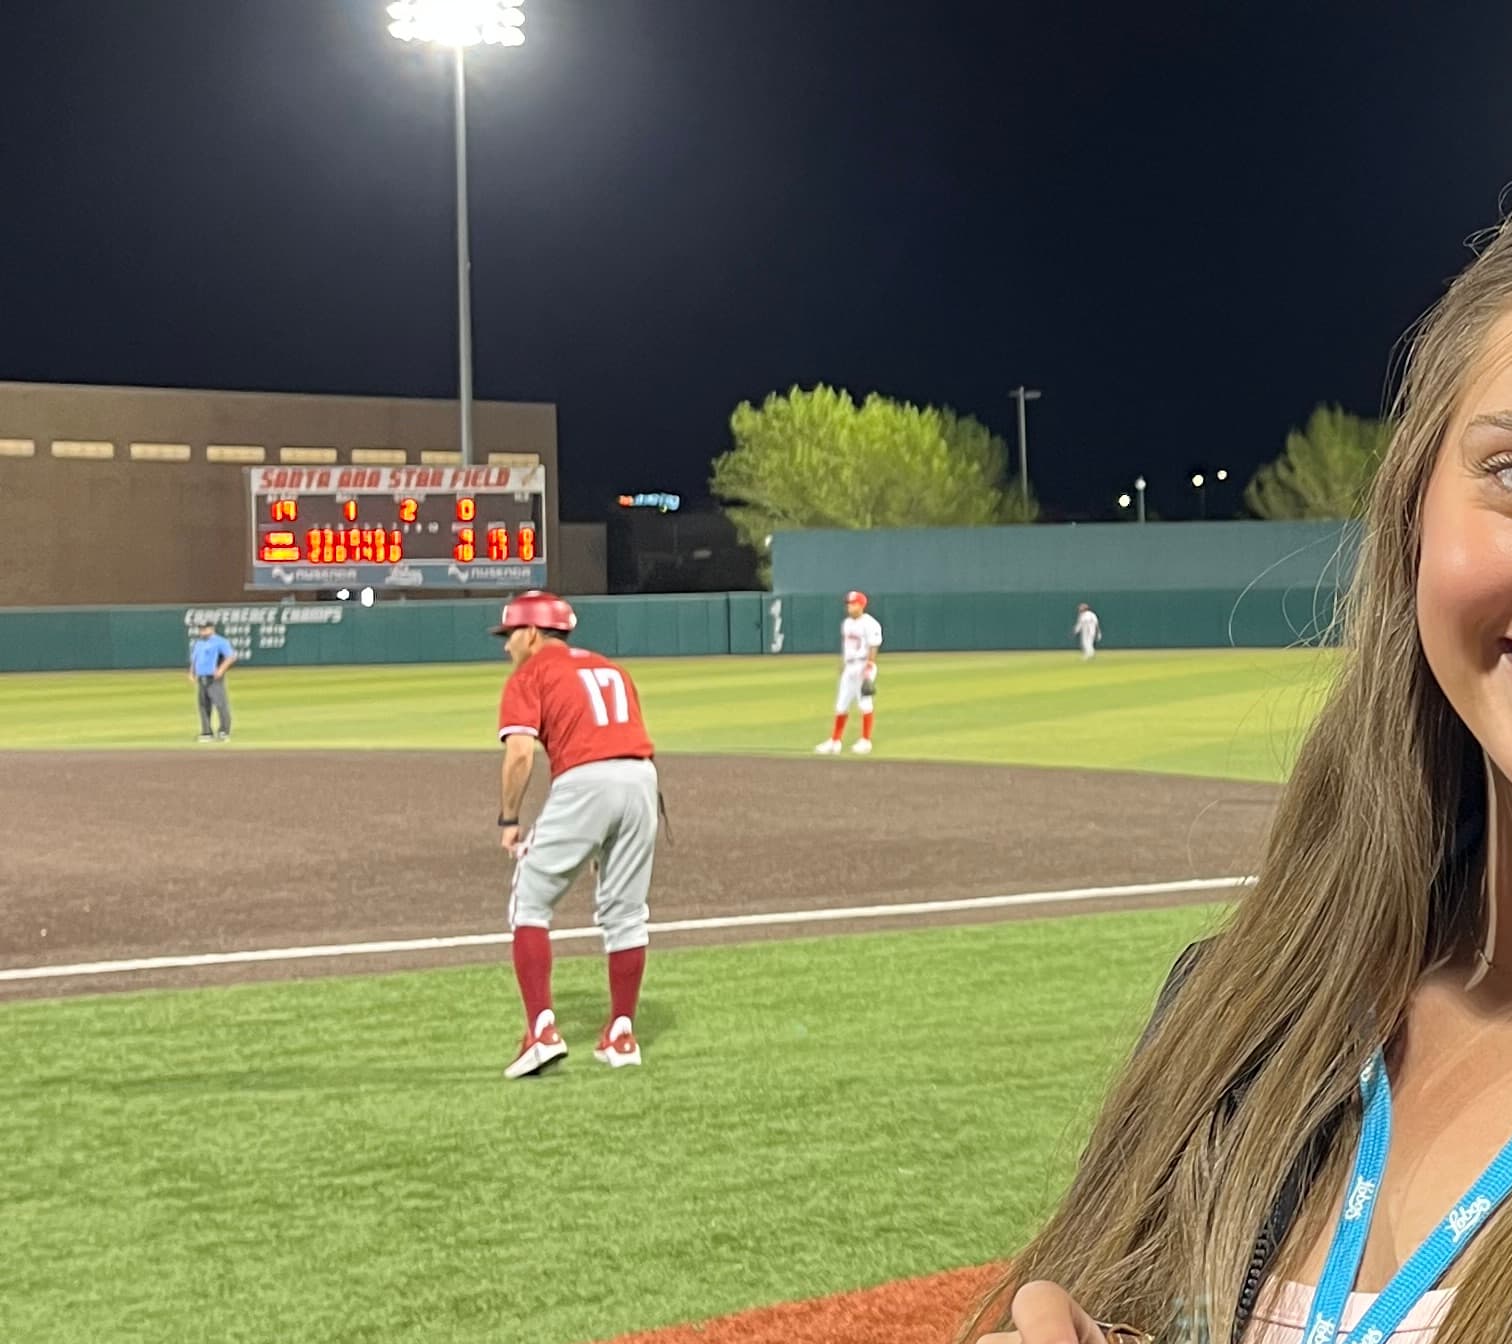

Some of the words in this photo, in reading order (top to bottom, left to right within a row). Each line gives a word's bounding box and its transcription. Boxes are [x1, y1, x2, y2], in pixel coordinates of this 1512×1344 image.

[262, 468, 332, 489] SANTA
[338, 468, 381, 489] ANA
[388, 467, 444, 488] STAR
[449, 467, 511, 488] FIELD
[400, 498, 418, 523] 2
[456, 498, 476, 523] 0
[184, 607, 279, 625] CONFERENCE
[280, 606, 344, 624] CHAMPS
[577, 668, 629, 726] 17
[1448, 1196, 1492, 1243] Lobos
